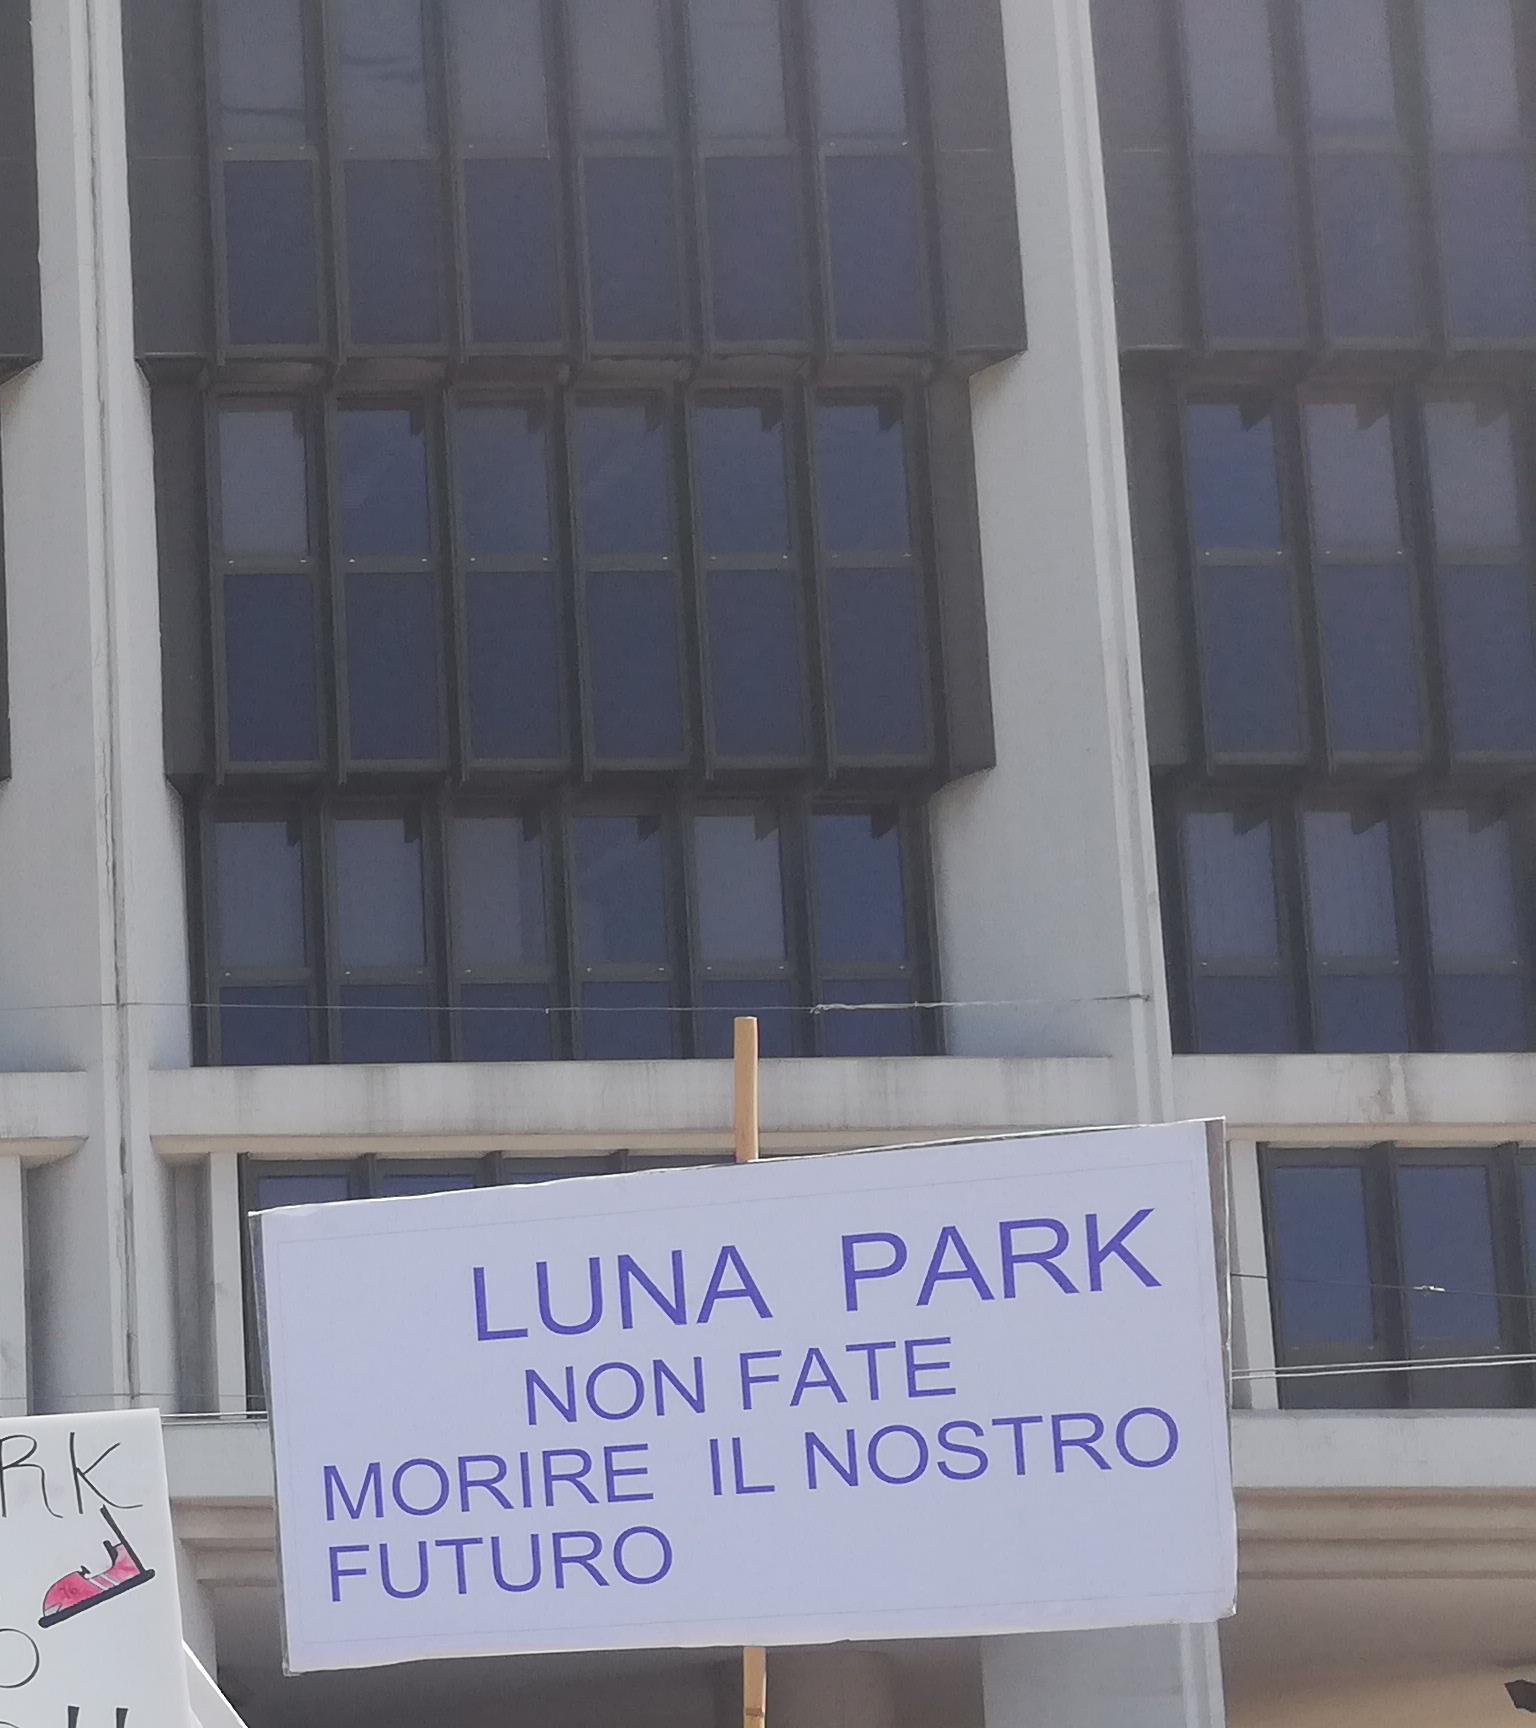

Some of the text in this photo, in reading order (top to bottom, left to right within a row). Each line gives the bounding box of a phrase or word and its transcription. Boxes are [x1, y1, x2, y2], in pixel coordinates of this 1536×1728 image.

[471, 1206, 1163, 1342] LUNA PARK
[522, 1335, 958, 1426] NON FATE
[322, 1406, 1181, 1521] MORIRE IL NOSTRO
[326, 1525, 675, 1603] FUTURO
